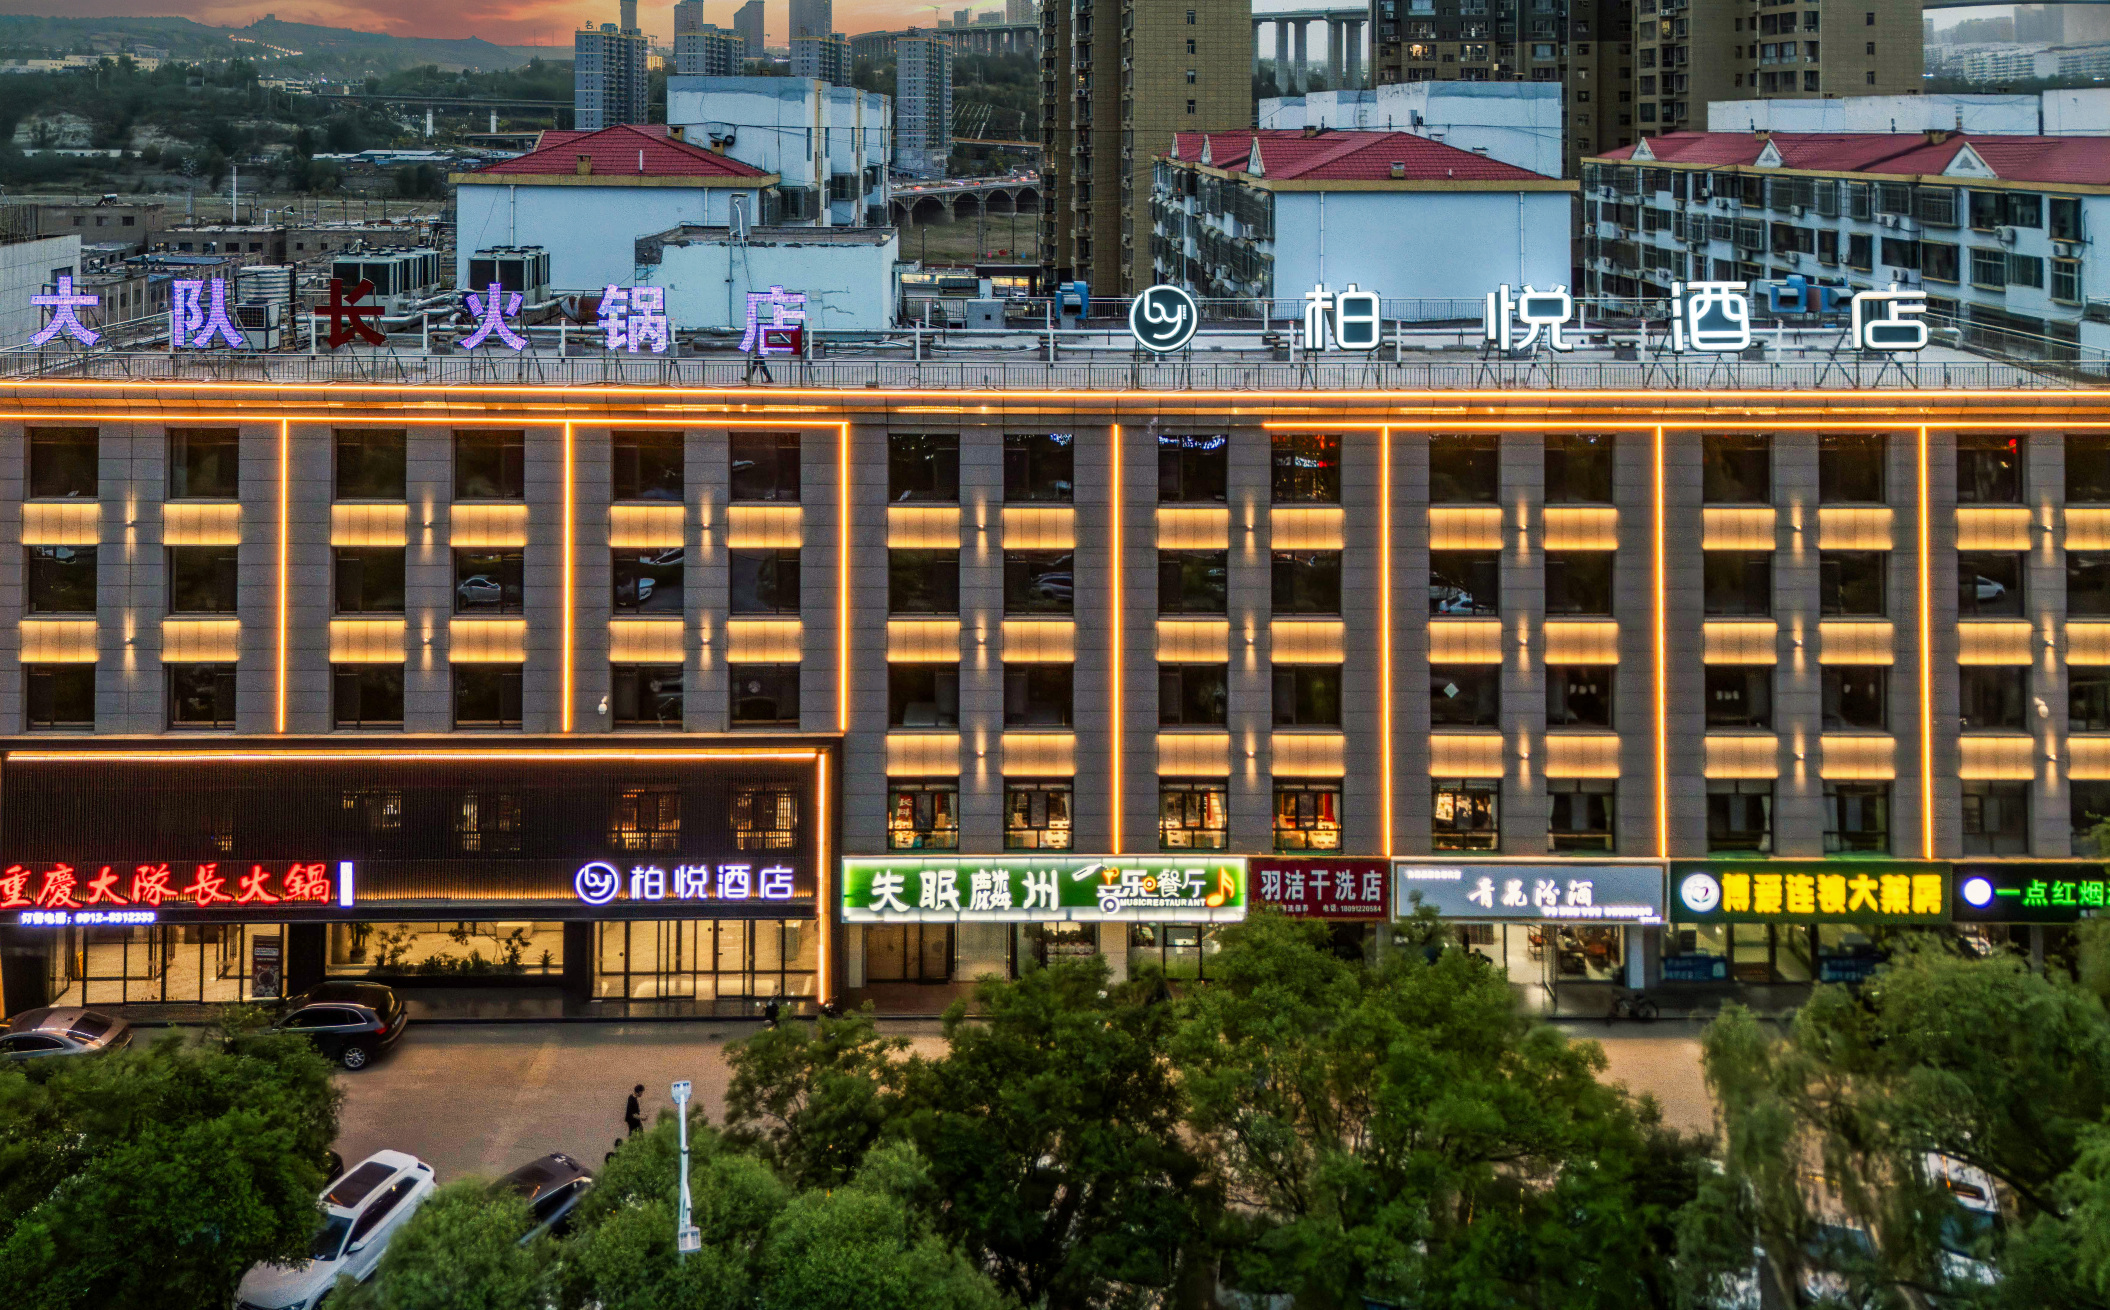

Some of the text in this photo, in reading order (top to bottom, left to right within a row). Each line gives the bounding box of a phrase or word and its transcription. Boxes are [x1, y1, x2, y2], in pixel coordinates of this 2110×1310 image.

[1304, 281, 1928, 353] 柏悦酒店
[630, 864, 794, 900] 柏悦酒店
[868, 868, 1060, 912] 失眠麟州
[1261, 869, 1382, 901] 羽洁干洗店
[1995, 879, 2110, 907] 一点红烟
